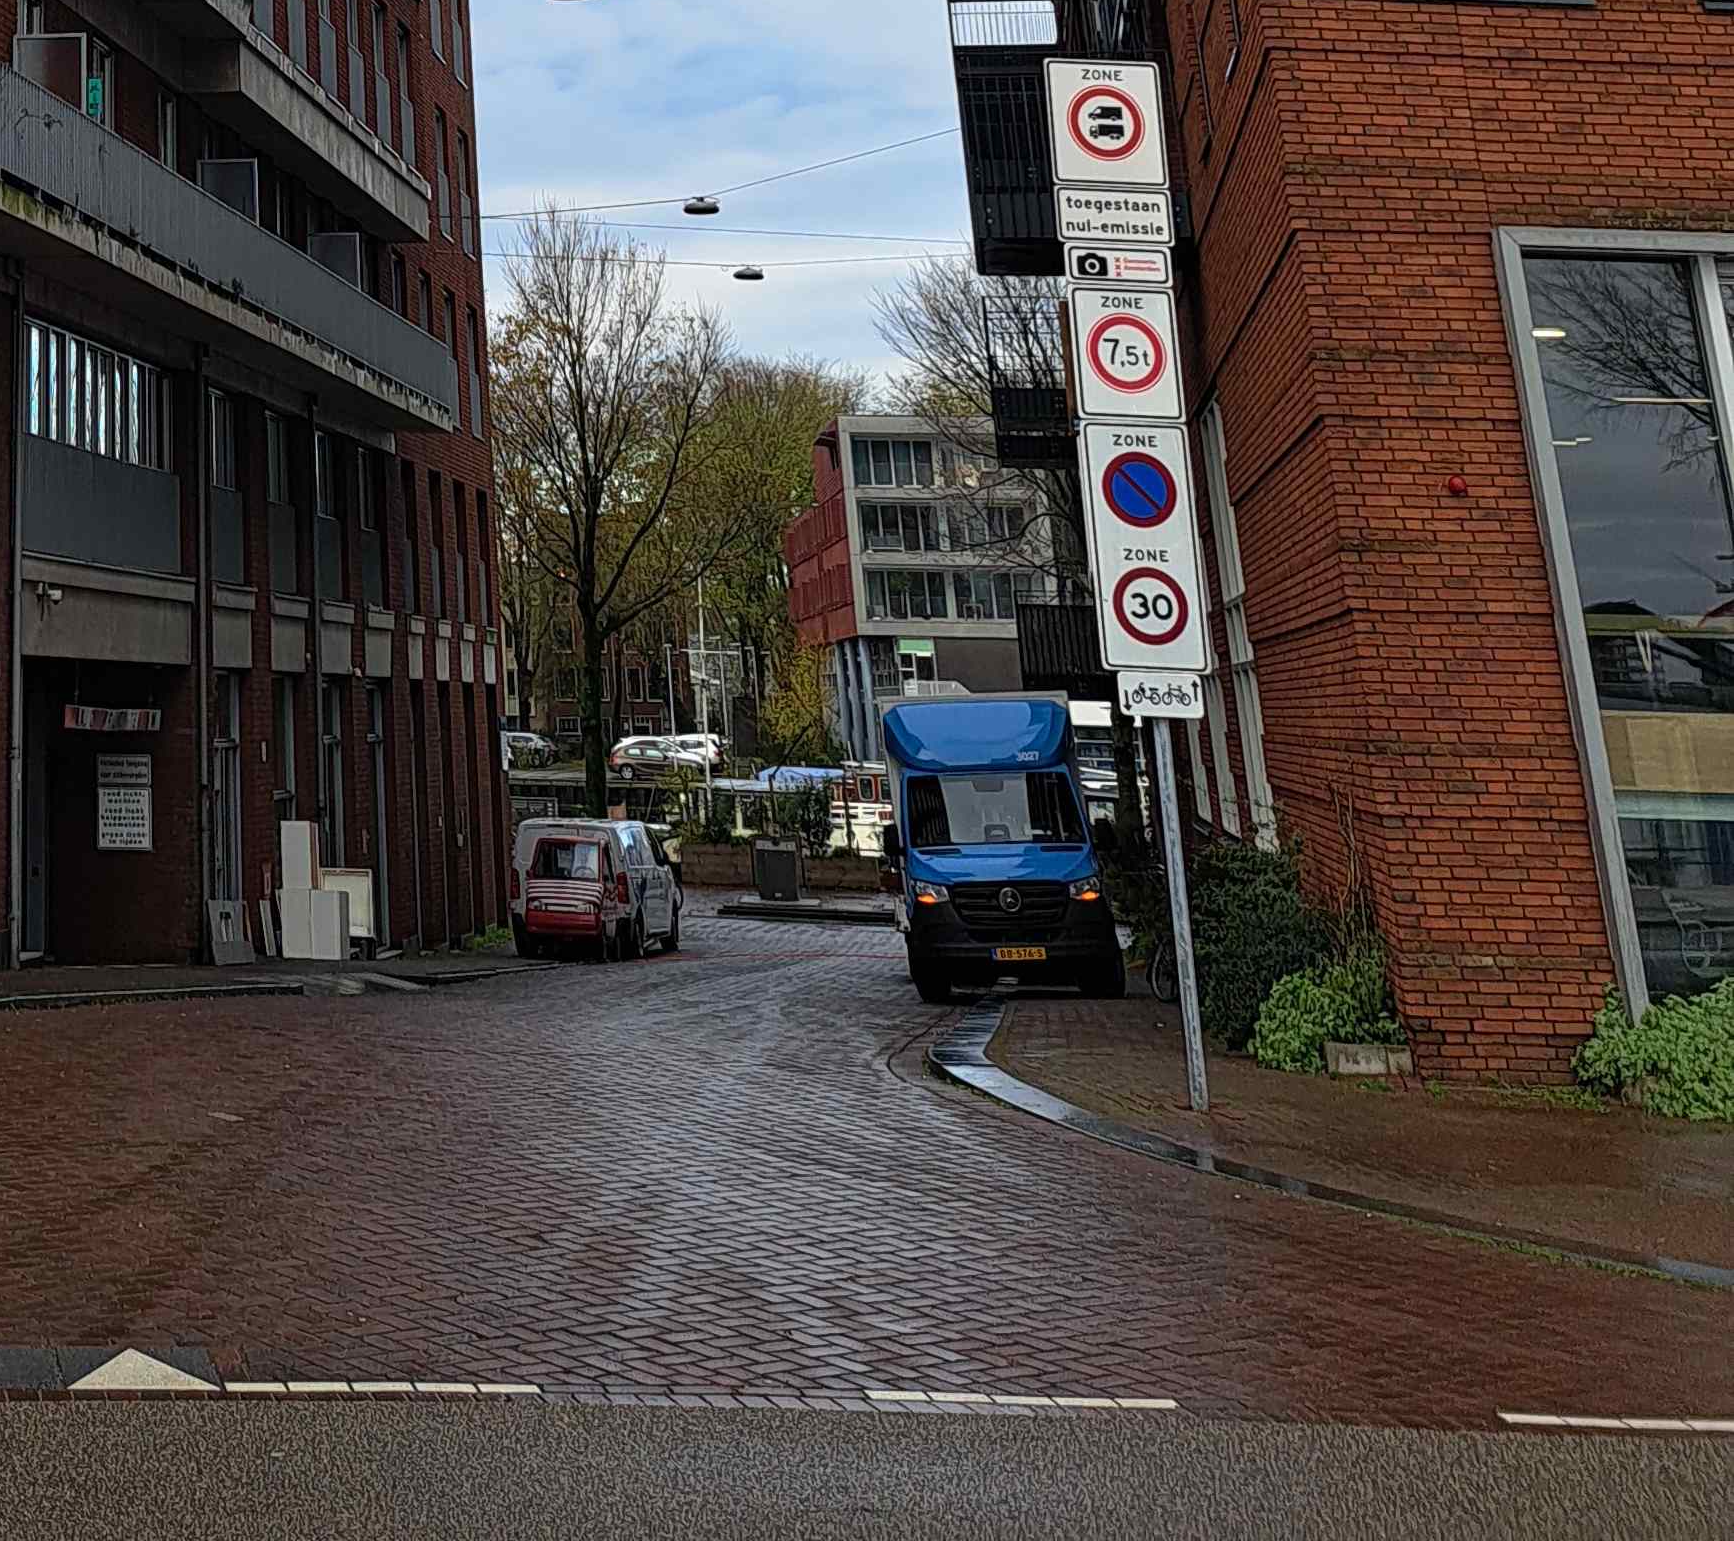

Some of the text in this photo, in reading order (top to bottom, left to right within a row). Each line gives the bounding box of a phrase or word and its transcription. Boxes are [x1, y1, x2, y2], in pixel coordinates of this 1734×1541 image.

[1081, 69, 1123, 82] ZONE
[1065, 195, 1162, 215] toegestaan
[1066, 219, 1165, 236] nul-emissie
[1100, 296, 1145, 310] ZONE
[1112, 434, 1159, 448] ZONE
[1123, 548, 1170, 563] ZONE
[1129, 593, 1174, 621] 30
